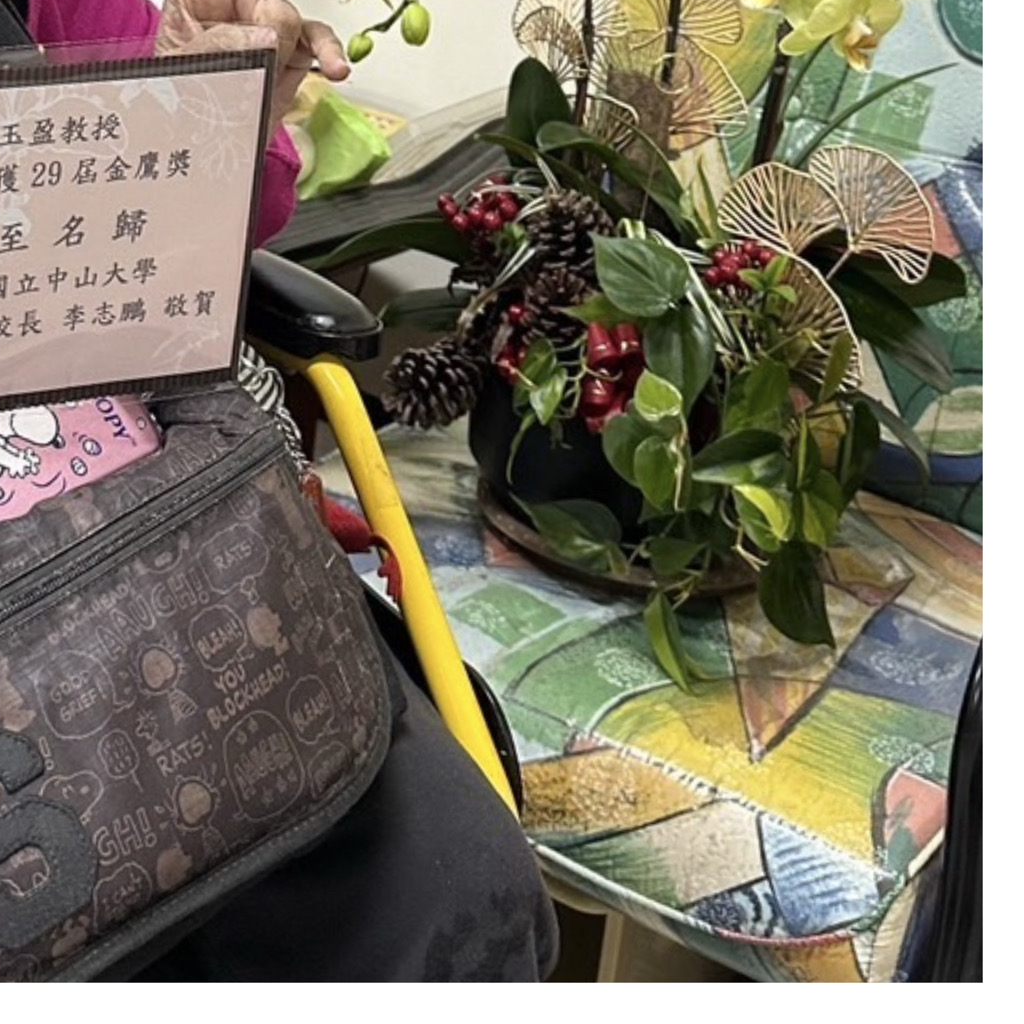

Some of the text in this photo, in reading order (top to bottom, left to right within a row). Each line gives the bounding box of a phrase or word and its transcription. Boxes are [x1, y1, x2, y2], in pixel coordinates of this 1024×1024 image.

[31, 161, 62, 188] 29
[62, 297, 147, 331] 李志鵬
[164, 289, 216, 319] 敬賀
[214, 663, 246, 694] YOU
[156, 731, 214, 776] RATS!
